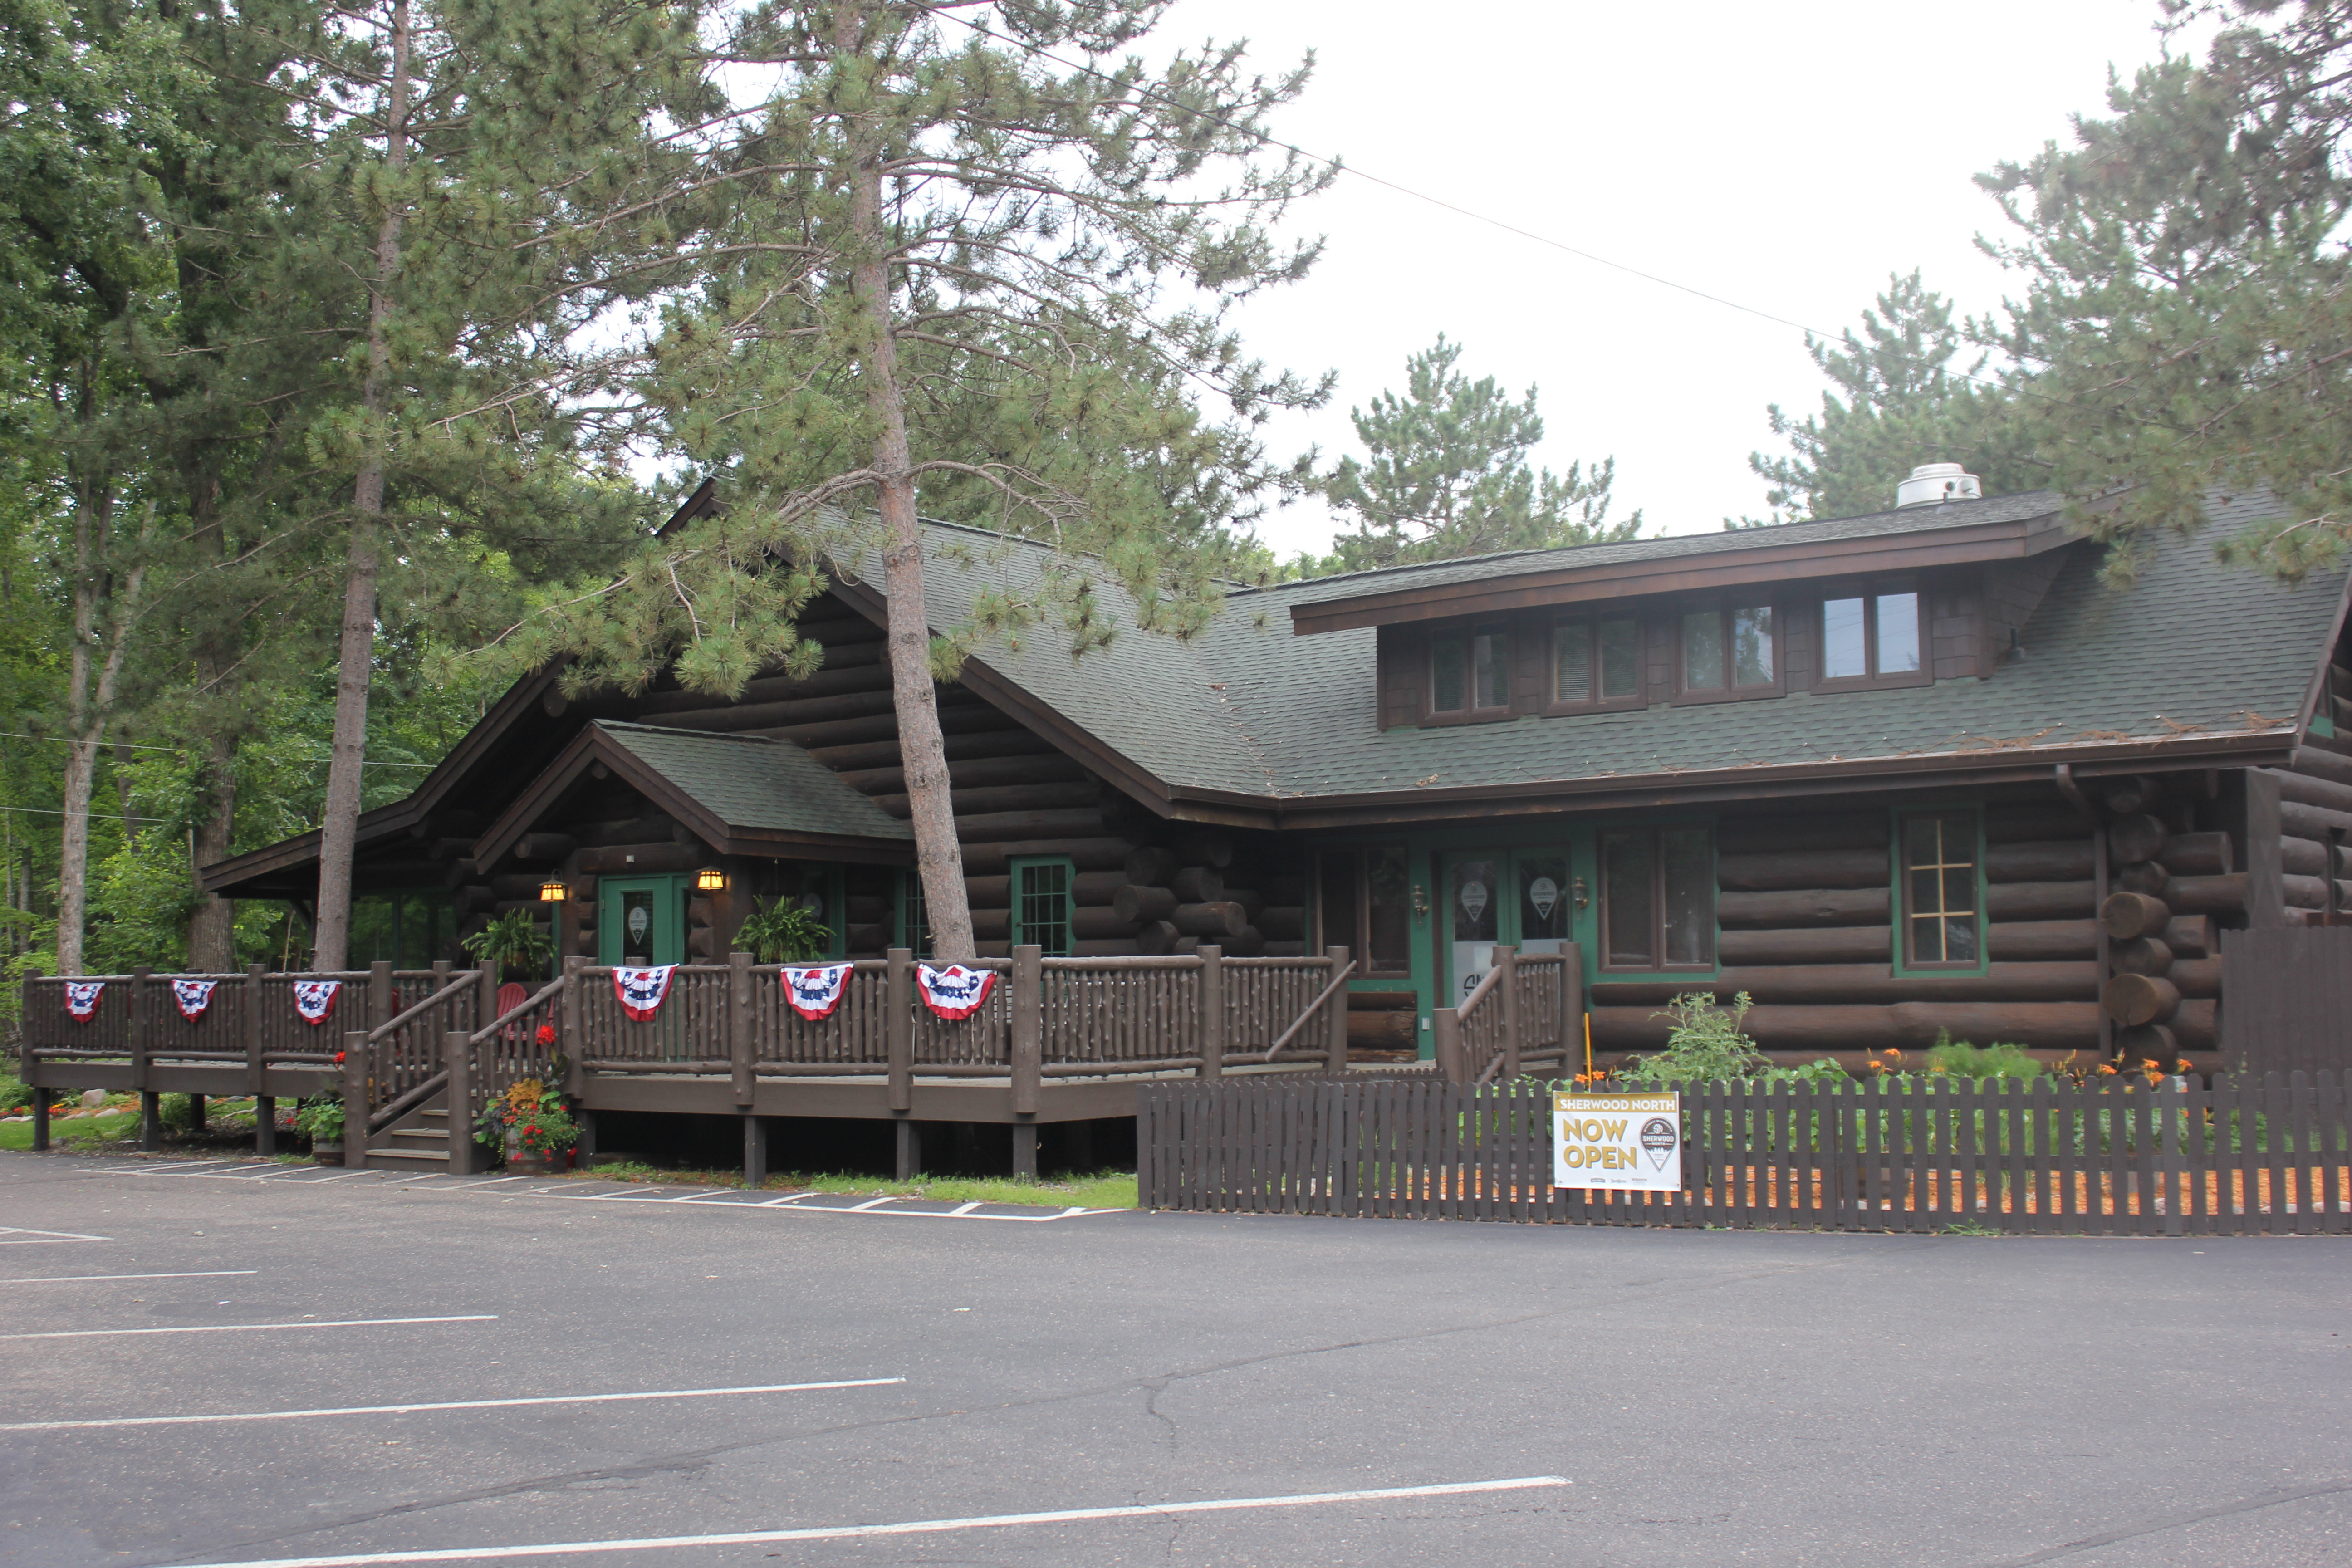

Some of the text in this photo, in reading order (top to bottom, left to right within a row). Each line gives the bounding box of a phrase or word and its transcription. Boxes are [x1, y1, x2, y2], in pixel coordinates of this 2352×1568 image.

[1560, 1099, 1676, 1111] SHERWOOD NORTH
[1563, 1118, 1628, 1142] NOW
[1563, 1145, 1638, 1170] OPEN
